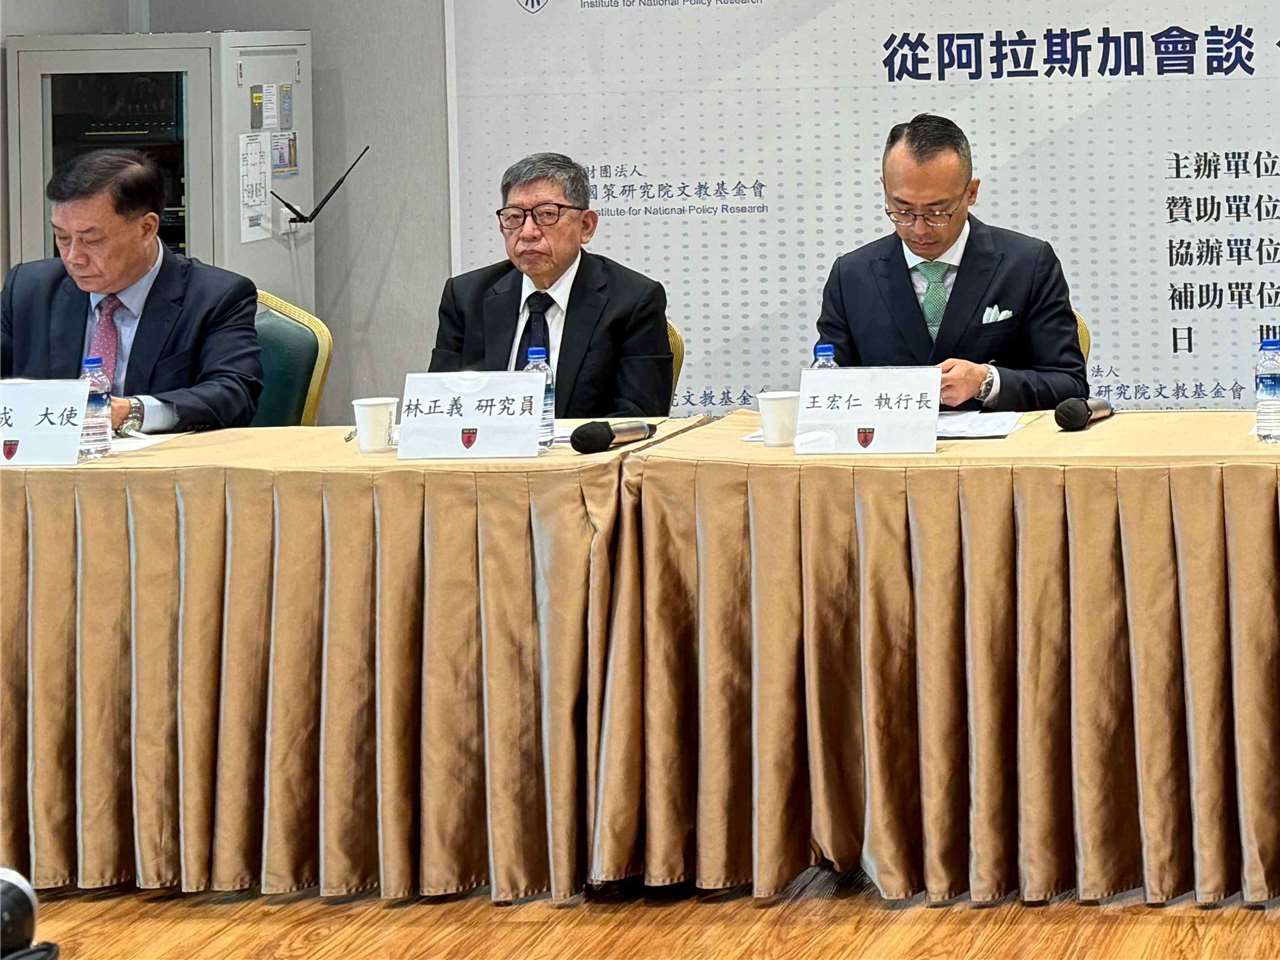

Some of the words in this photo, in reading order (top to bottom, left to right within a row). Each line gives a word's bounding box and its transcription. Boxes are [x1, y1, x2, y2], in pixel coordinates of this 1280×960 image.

[1165, 150, 1280, 180] 主辦單位
[596, 207, 626, 217] stitute
[629, 206, 642, 216] for
[644, 205, 686, 215] National
[689, 204, 718, 216] Policy
[721, 203, 769, 214] Research
[1165, 193, 1280, 224] 贊助單位
[404, 396, 464, 418] 林正義
[475, 395, 535, 417] 研究員
[805, 393, 863, 411] 王宏仁
[874, 392, 932, 411] 執行長
[34, 406, 79, 428] 大使
